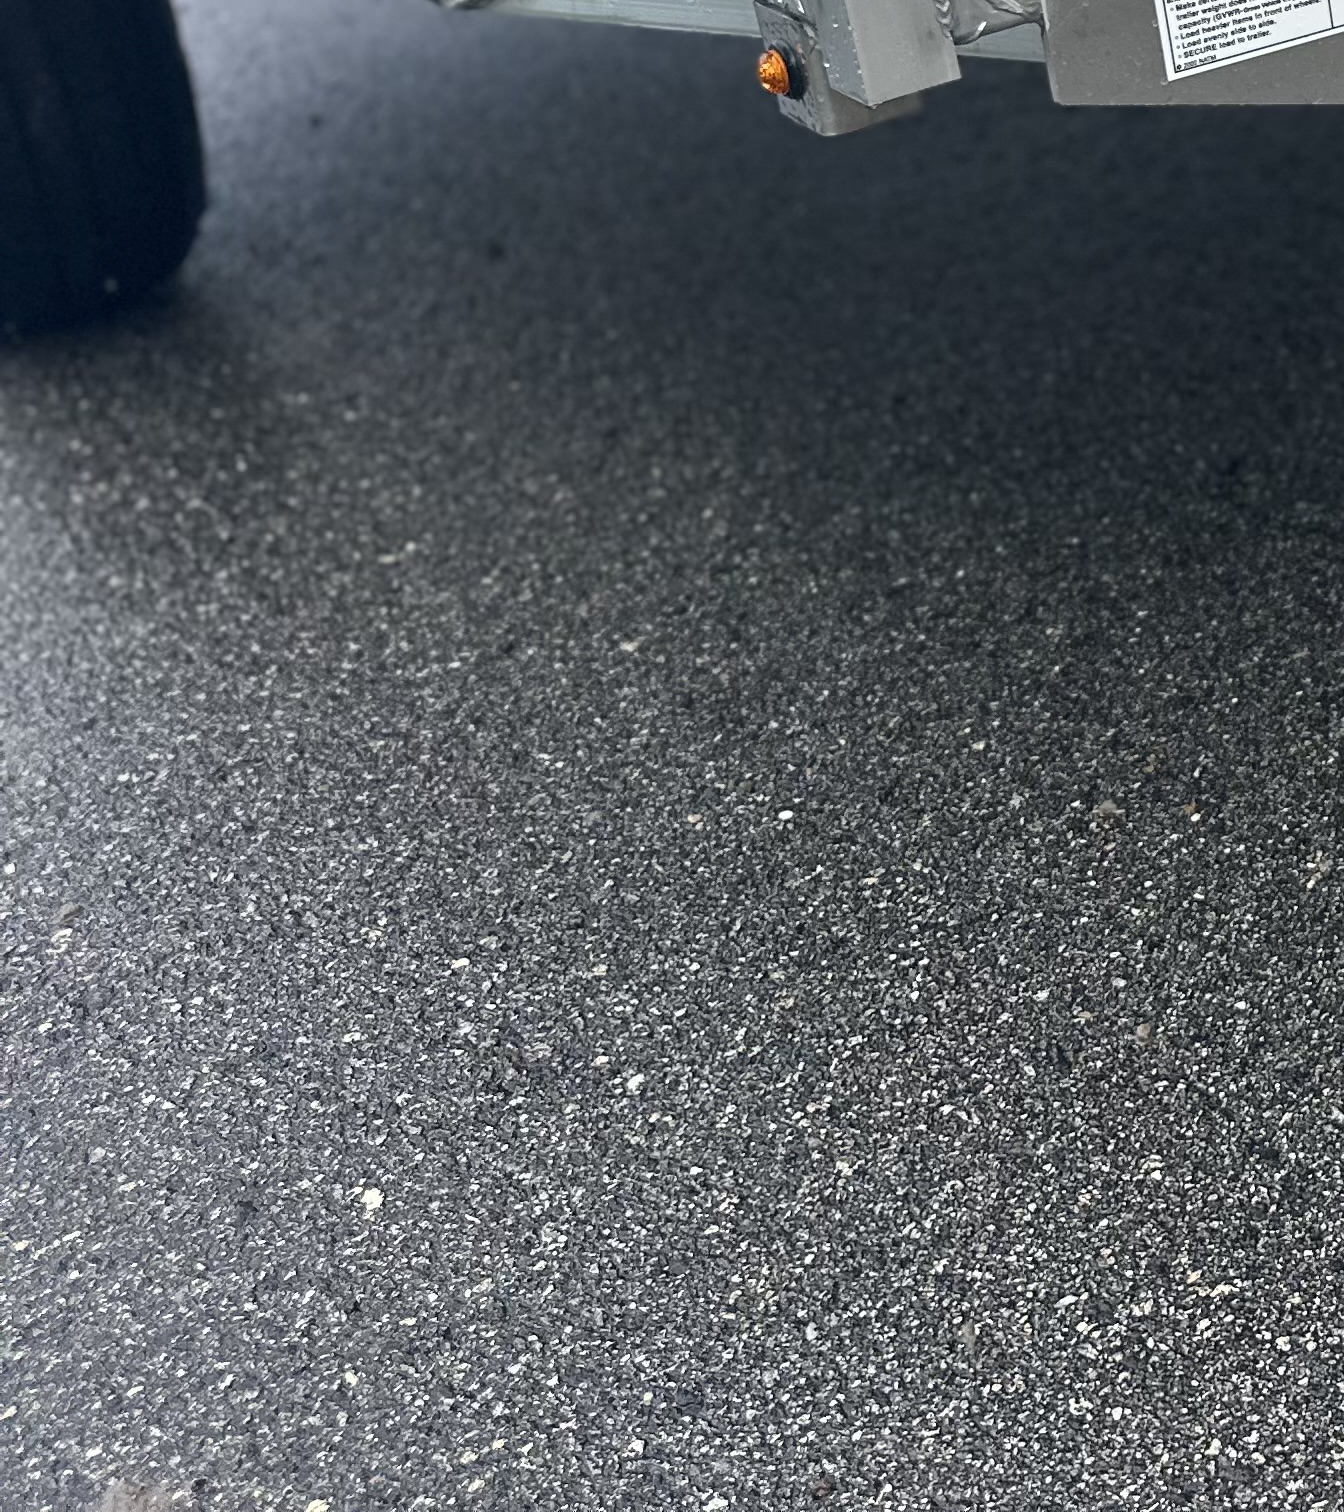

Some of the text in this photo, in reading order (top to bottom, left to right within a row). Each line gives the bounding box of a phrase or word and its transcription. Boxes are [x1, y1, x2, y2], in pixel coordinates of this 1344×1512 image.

[1176, 1, 1196, 11] Make
[1176, 10, 1199, 21] trailer
[1201, 2, 1227, 15] weight
[1178, 16, 1211, 32] capacity
[1180, 29, 1200, 40] Load
[1202, 21, 1230, 34] heavier
[1232, 15, 1253, 26] items
[1264, 7, 1282, 17] front
[1182, 39, 1201, 49] Load
[1203, 31, 1229, 44] evenly
[1230, 26, 1247, 35] side
[1258, 18, 1276, 28] side.
[1183, 44, 1217, 58] SECURE
[1219, 39, 1236, 48] load
